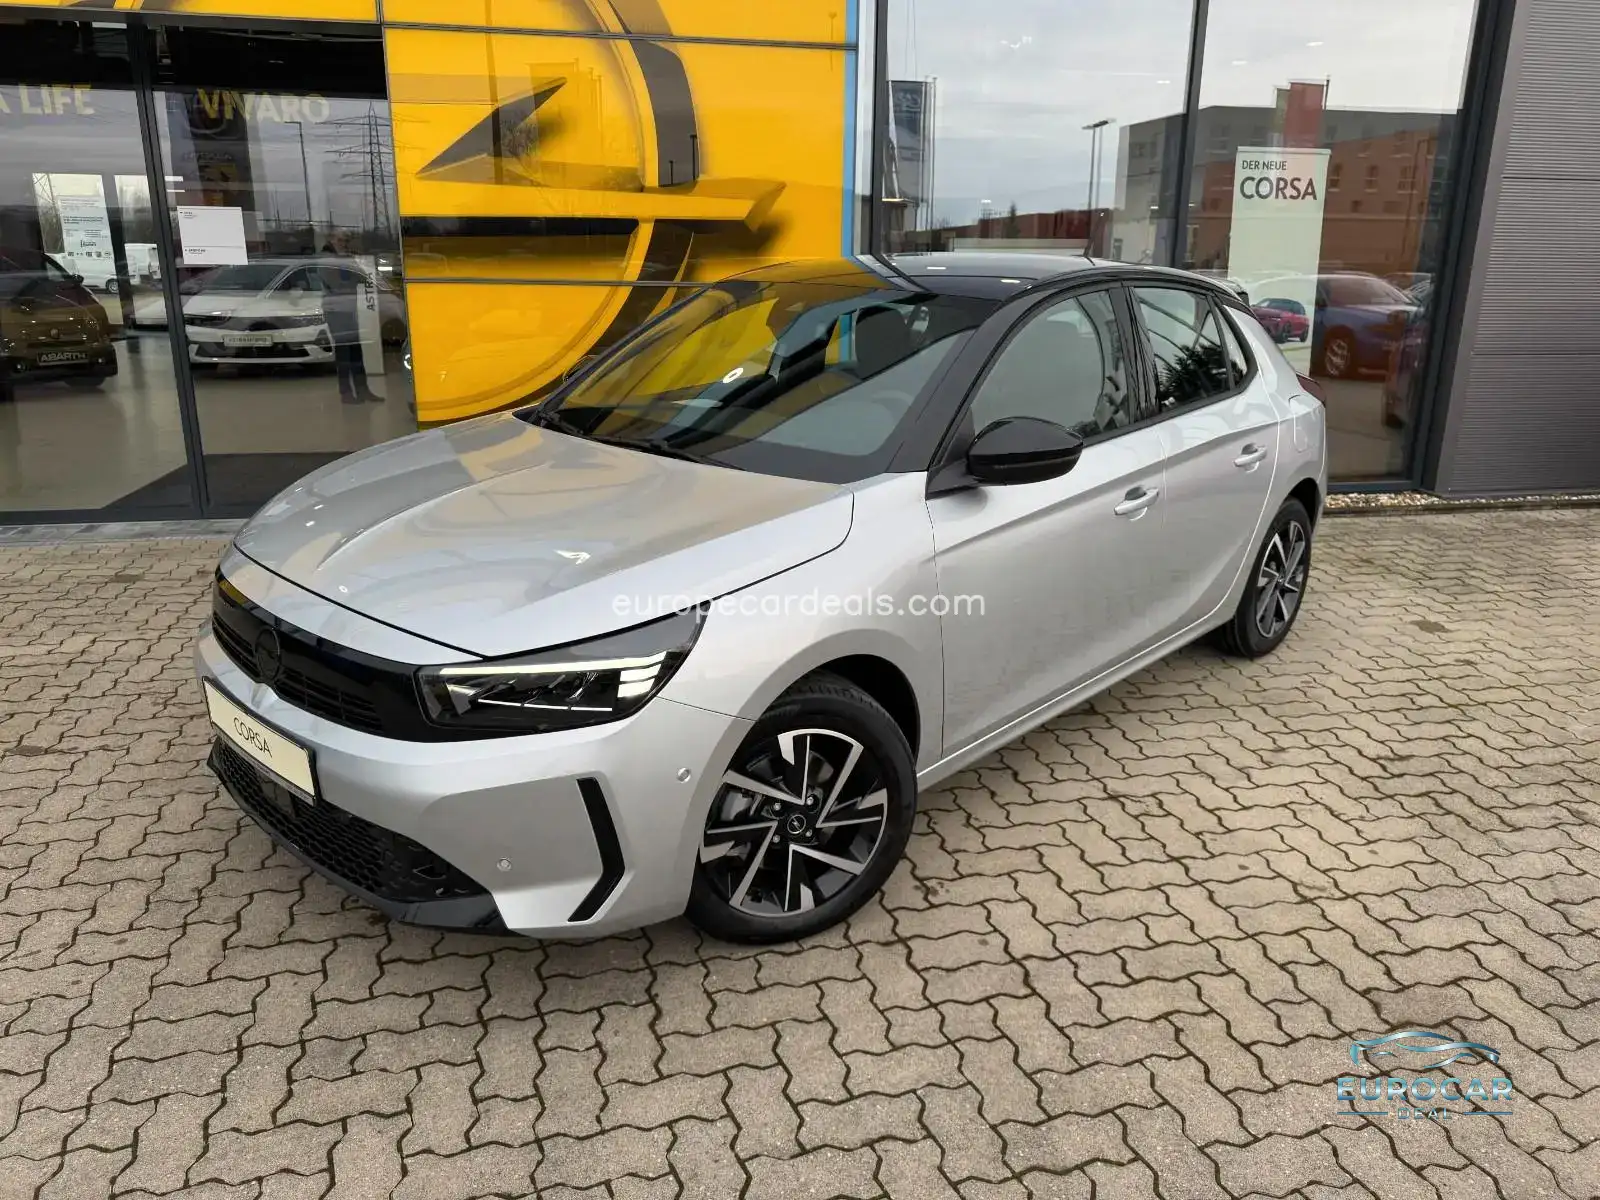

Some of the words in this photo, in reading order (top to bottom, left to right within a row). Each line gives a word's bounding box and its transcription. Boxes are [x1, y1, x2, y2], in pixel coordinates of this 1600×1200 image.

[19, 83, 95, 115] LIFE
[197, 88, 330, 123] VIVARO
[1242, 160, 1260, 170] DER
[1263, 160, 1287, 170] NEUE
[1240, 176, 1317, 200] CORSA
[40, 351, 86, 362] ABARTH
[233, 716, 273, 759] CORSA
